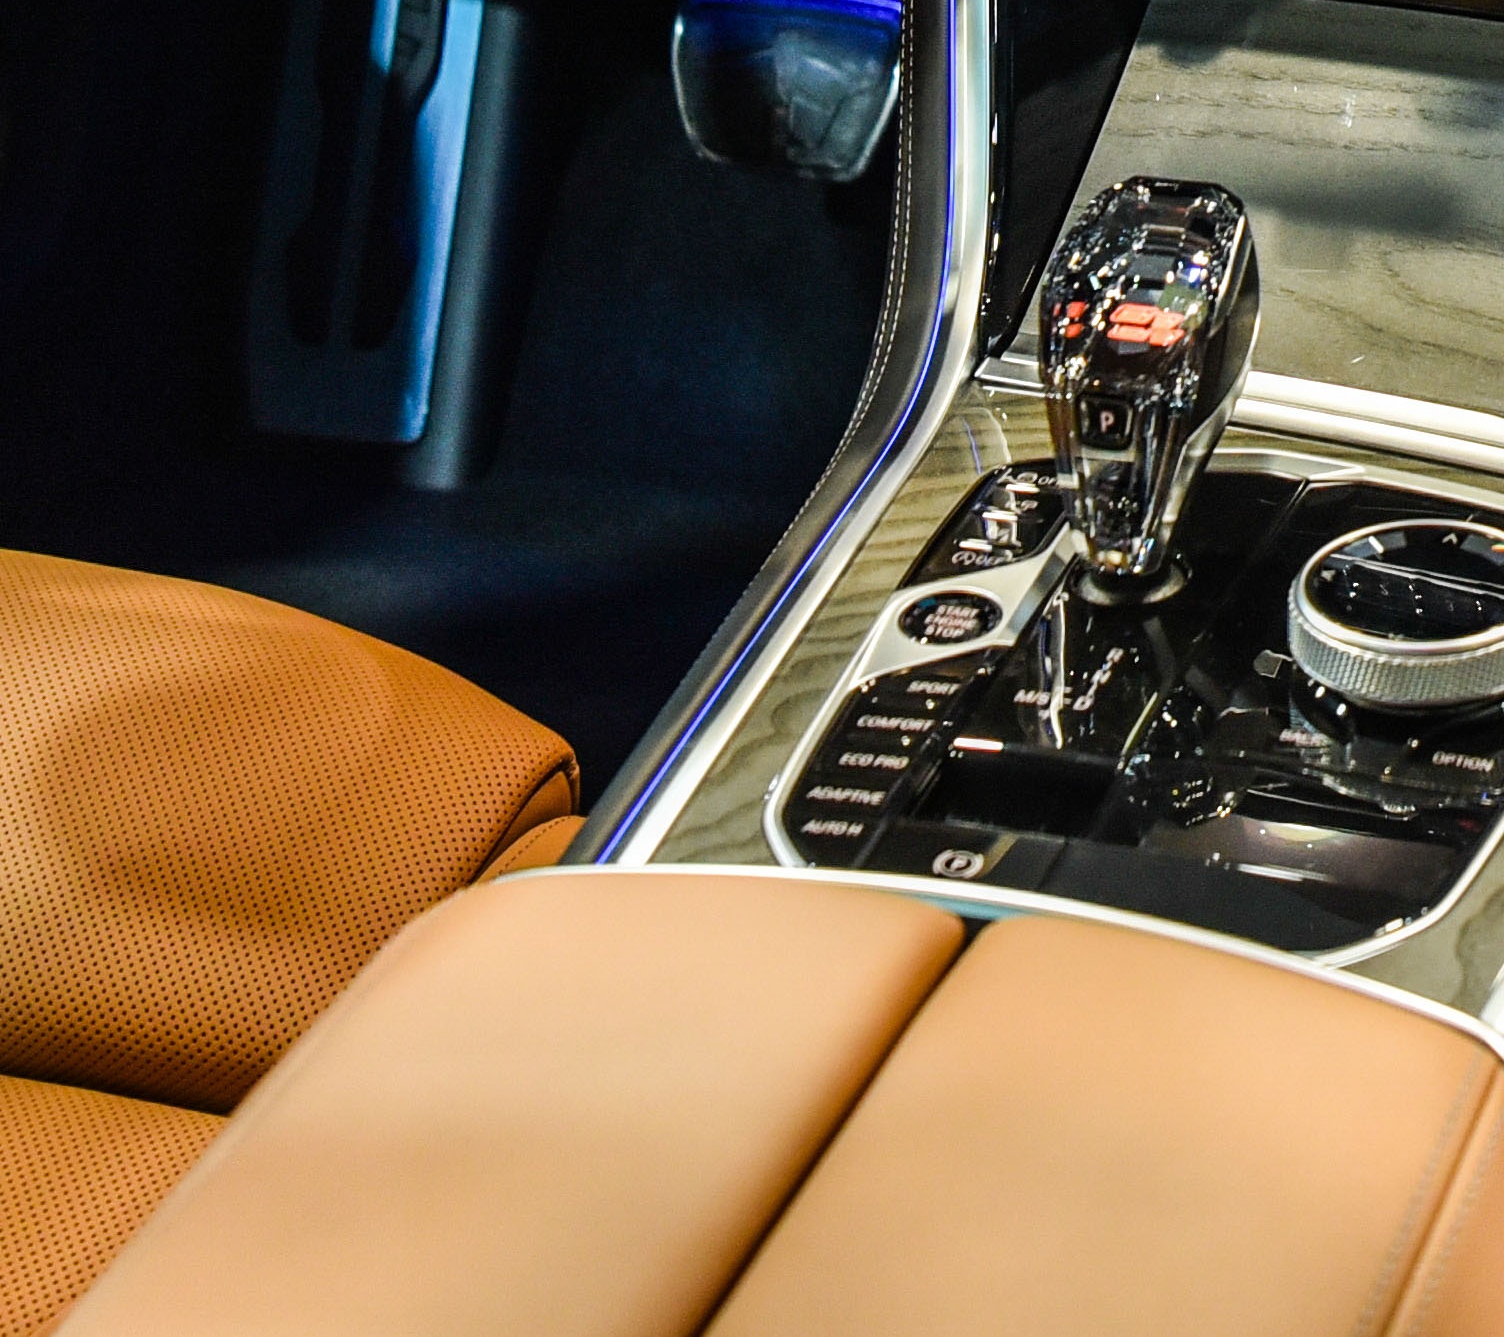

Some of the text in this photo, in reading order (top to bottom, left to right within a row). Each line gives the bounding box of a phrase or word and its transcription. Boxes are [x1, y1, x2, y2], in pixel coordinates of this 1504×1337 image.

[1100, 410, 1115, 433] P
[936, 604, 980, 618] START
[924, 614, 979, 630] ENGINE
[924, 625, 966, 639] STOP
[906, 680, 962, 695] SPORT
[856, 714, 936, 732] COMFORT
[838, 751, 910, 770] ECO PRO
[1431, 750, 1496, 773] OPTION
[805, 785, 887, 806] ADAPTIVE
[800, 819, 865, 838] AUTO H
